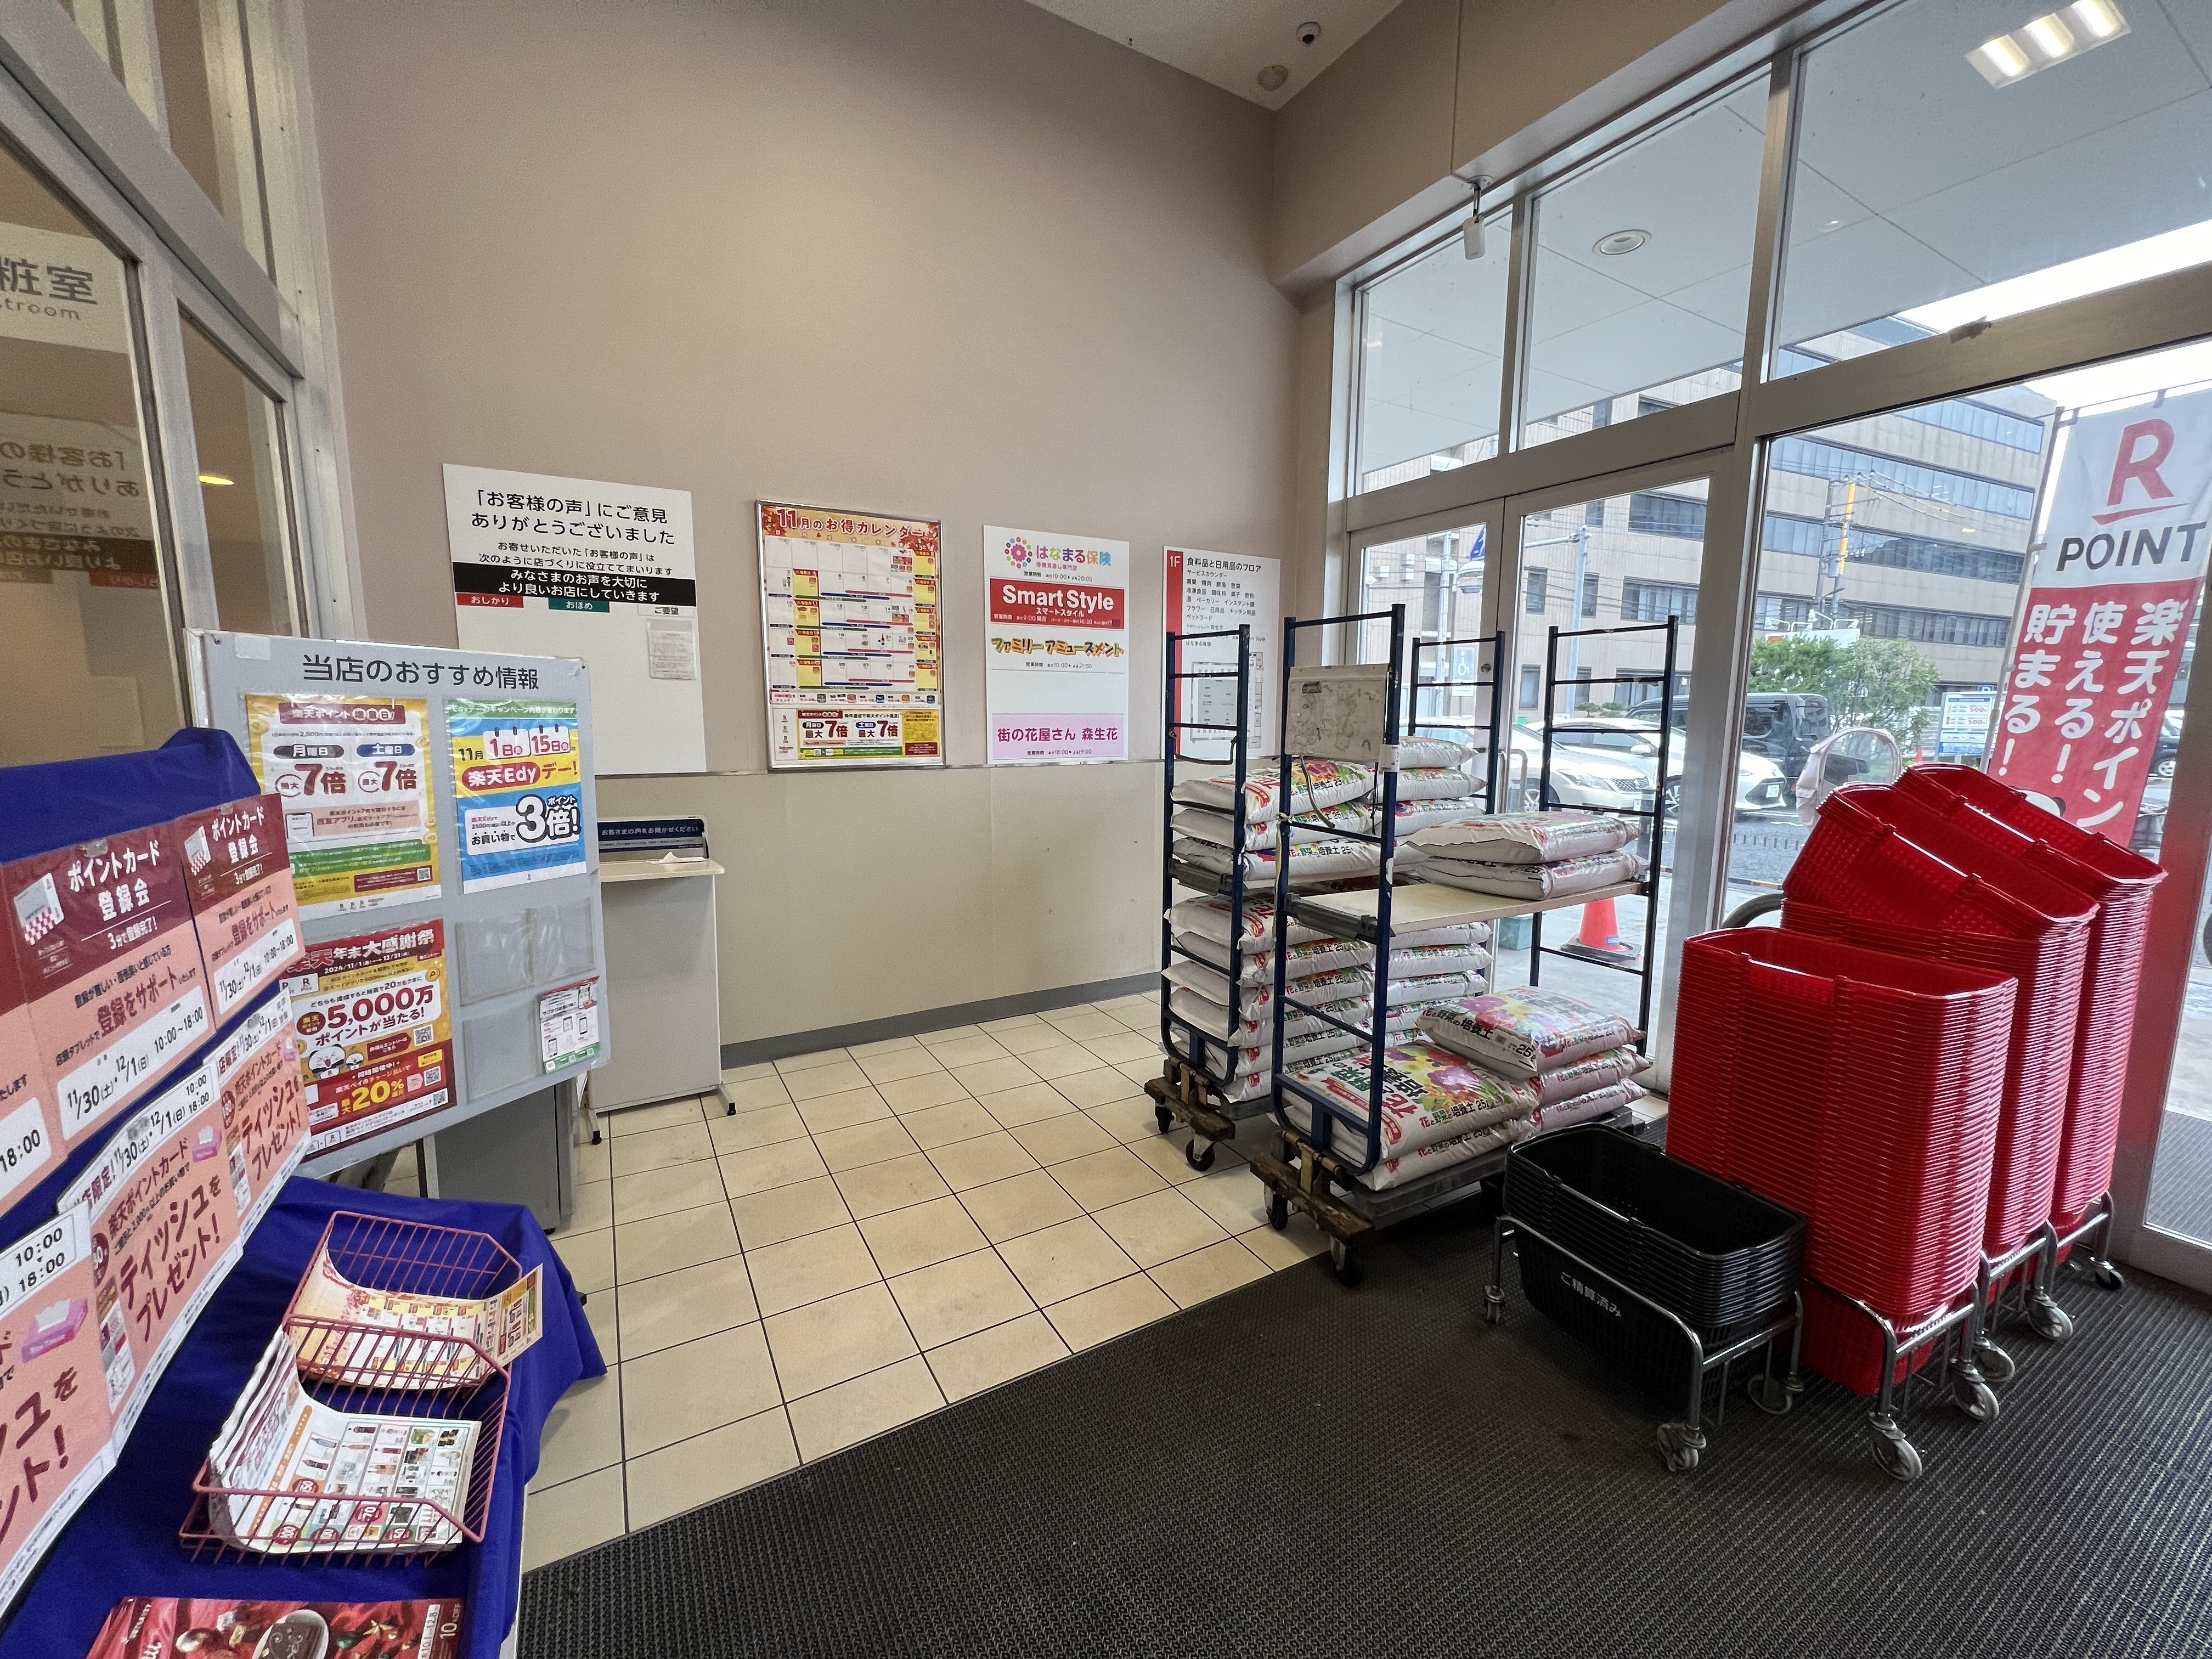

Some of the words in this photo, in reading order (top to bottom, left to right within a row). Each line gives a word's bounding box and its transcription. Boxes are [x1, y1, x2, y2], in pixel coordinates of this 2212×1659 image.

[0, 258, 97, 304] 粧室
[2107, 418, 2174, 506] R
[478, 489, 668, 524] 「お客様の声」にご意見
[472, 514, 675, 545] ありがとうございました
[776, 508, 924, 539] 11月のお得カレンダー
[1036, 545, 1111, 566] はなまる保険
[1169, 555, 1181, 568] 1F
[2056, 522, 2206, 572] POINT
[479, 553, 673, 576] 次のように店づくりに役立ててまいります
[511, 569, 647, 589] みなさまのお声を大切に
[1187, 557, 1261, 572] 食料品と日用品のフロア
[1187, 569, 1228, 578] サービスカウンター
[470, 596, 509, 606] おしかり
[499, 582, 660, 602] より良いお店にしていきます
[566, 600, 593, 611] おほめ
[1003, 585, 1064, 607] Smart
[1066, 589, 1114, 614] Style
[1036, 607, 1084, 617] スマートスタイル
[991, 637, 1044, 654] ファミリー
[302, 654, 540, 691] 当店のおすすめ情報
[1998, 604, 2077, 777] 貯まる!
[2055, 602, 2128, 784] 使える!
[997, 727, 1076, 742] 街の花屋さん
[1081, 727, 1118, 741] 森生花
[458, 748, 484, 761] 11月
[294, 763, 346, 795] 7倍
[374, 761, 417, 791] 7倍
[469, 761, 578, 787] 楽天Edyデー!
[212, 805, 265, 842] ポイントカード
[516, 794, 581, 843] 3倍!
[67, 839, 160, 893] ポイントカード
[97, 878, 150, 922] 登録会
[328, 984, 434, 1029] 5,000万
[315, 1006, 425, 1047] ポイントが当たる!
[1422, 1008, 1493, 1040] 花と野菜の培養土
[187, 1074, 207, 1096] 10:00
[189, 1091, 211, 1114] 18:00
[241, 1075, 300, 1155] ティッシュを
[1419, 1102, 1476, 1128] 花と野菜の培養土
[251, 1104, 302, 1182] プレゼント!
[108, 1138, 189, 1240] 楽天ポイントカード
[15, 1227, 64, 1267] 10:00
[120, 1175, 222, 1311] ティッシュを
[19, 1251, 65, 1293] 18:00
[136, 1212, 221, 1342] プレゼント!
